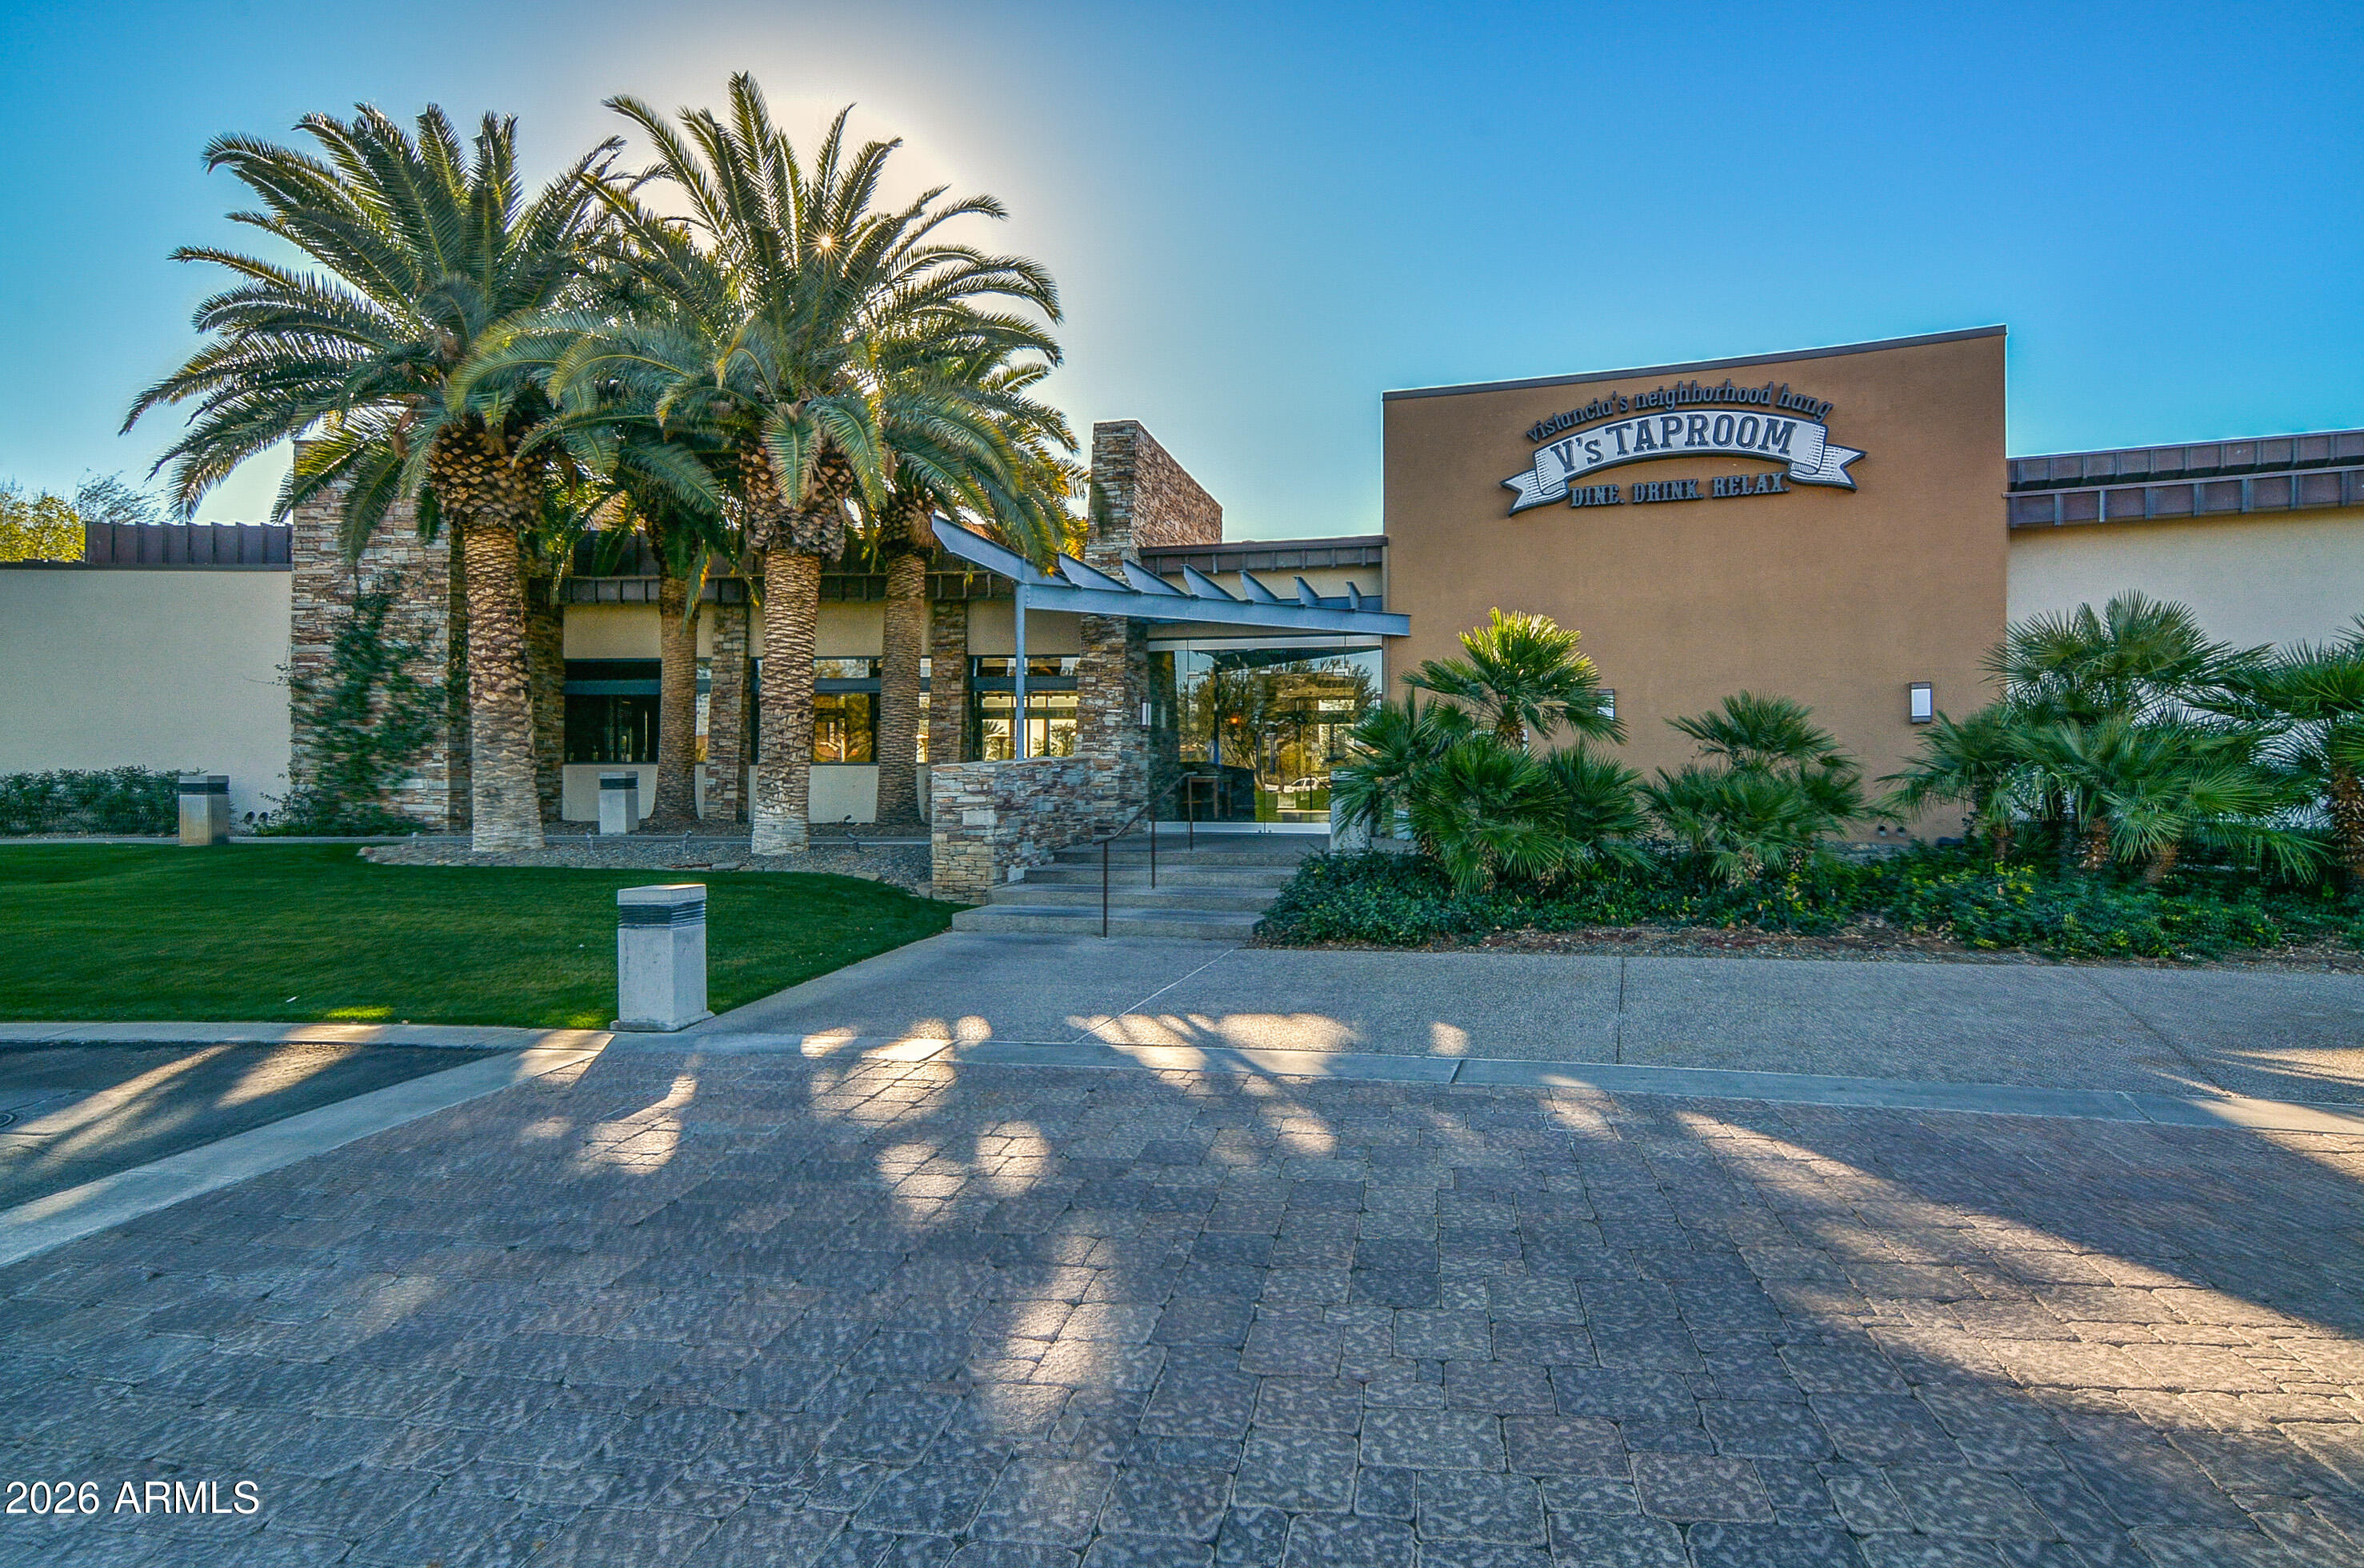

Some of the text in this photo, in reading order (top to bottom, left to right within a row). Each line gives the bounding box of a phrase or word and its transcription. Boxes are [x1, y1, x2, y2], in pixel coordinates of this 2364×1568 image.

[1526, 379, 1833, 443] vistancia's neighborhood hang
[1606, 414, 1798, 457] TAPROOM
[1570, 473, 1790, 508] DINE. DRINK. RELAX.
